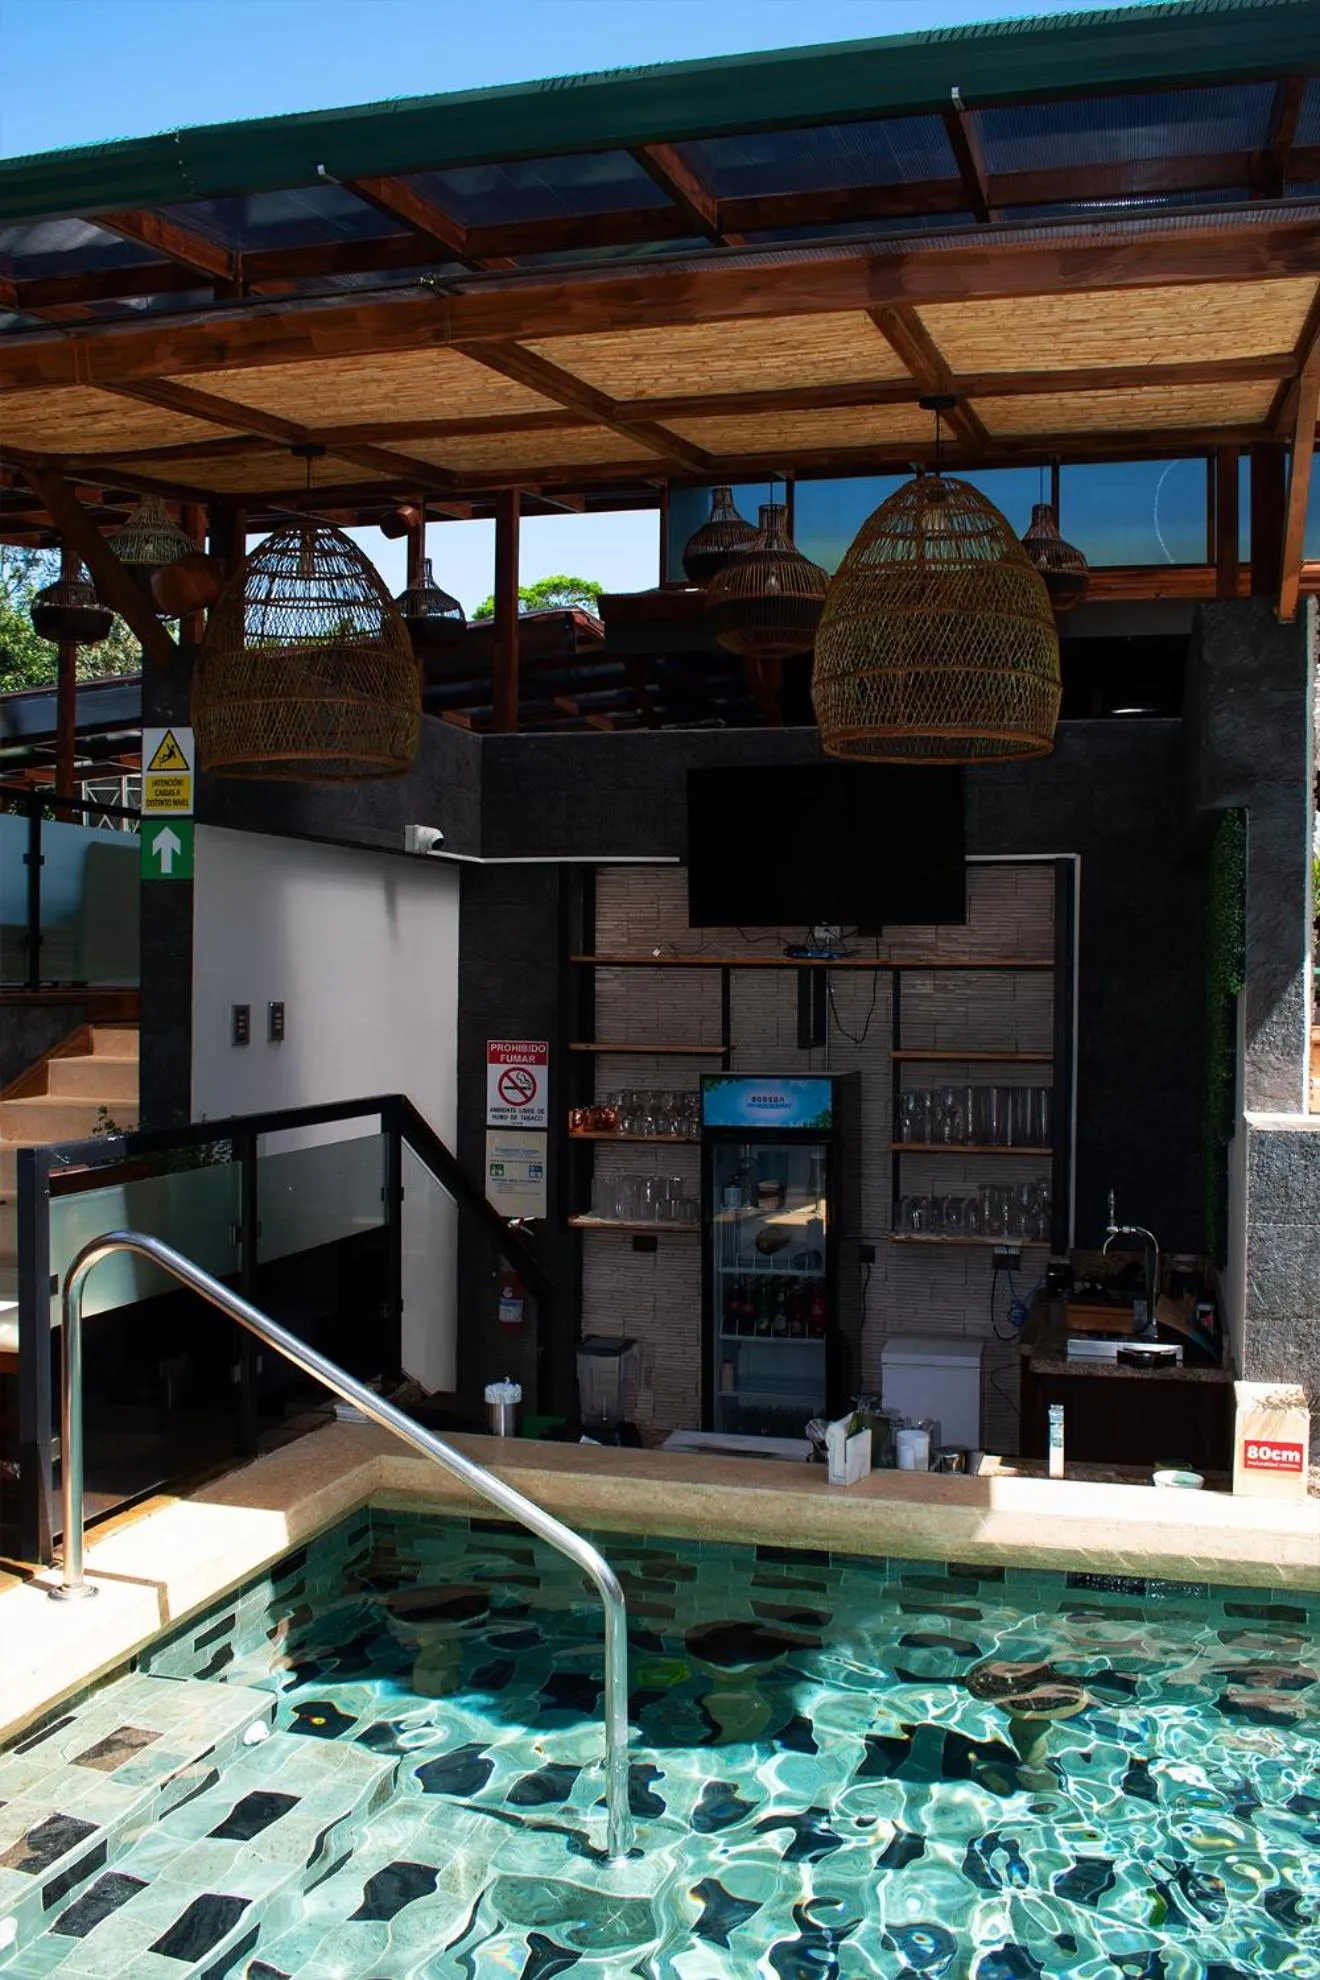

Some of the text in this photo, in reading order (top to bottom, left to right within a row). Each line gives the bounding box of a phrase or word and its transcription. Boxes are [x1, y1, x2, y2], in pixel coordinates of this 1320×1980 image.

[490, 1043, 546, 1053] PROHIBIDO
[500, 1054, 536, 1063] FUMAR
[1247, 1444, 1301, 1463] 80cm
